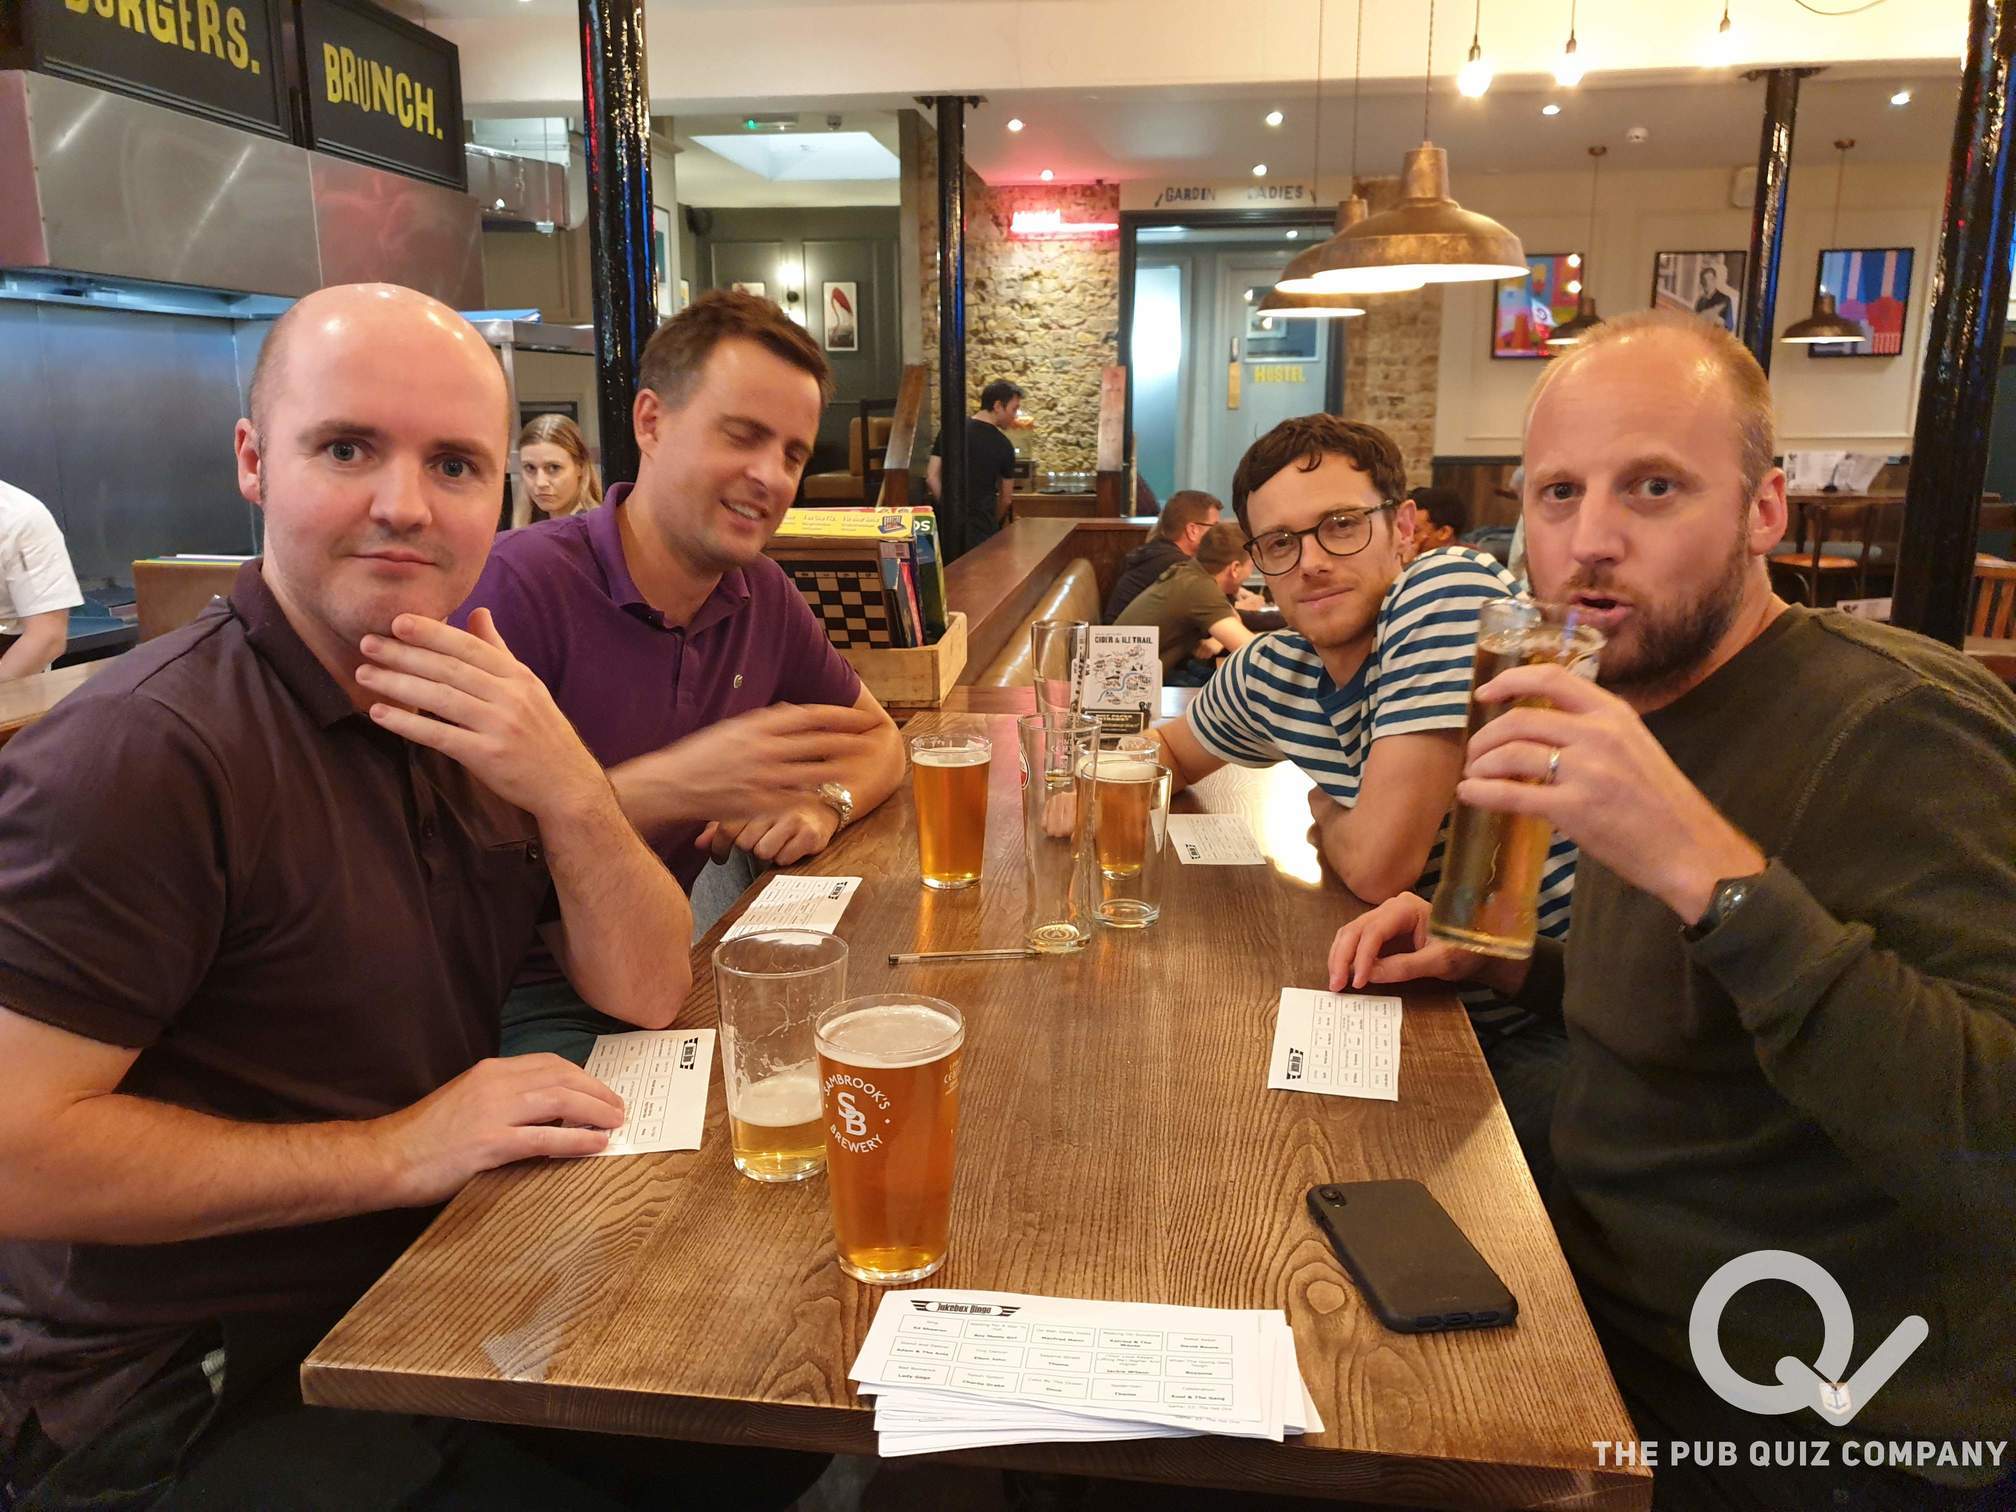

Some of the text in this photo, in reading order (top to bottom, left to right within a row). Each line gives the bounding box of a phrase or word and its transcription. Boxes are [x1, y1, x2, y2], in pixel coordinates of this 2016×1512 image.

[65, 0, 261, 75] RGERS.
[323, 42, 443, 140] BRUNCH.
[824, 1074, 891, 1110] SAMBROOK'S
[830, 1123, 883, 1153] BREWERY
